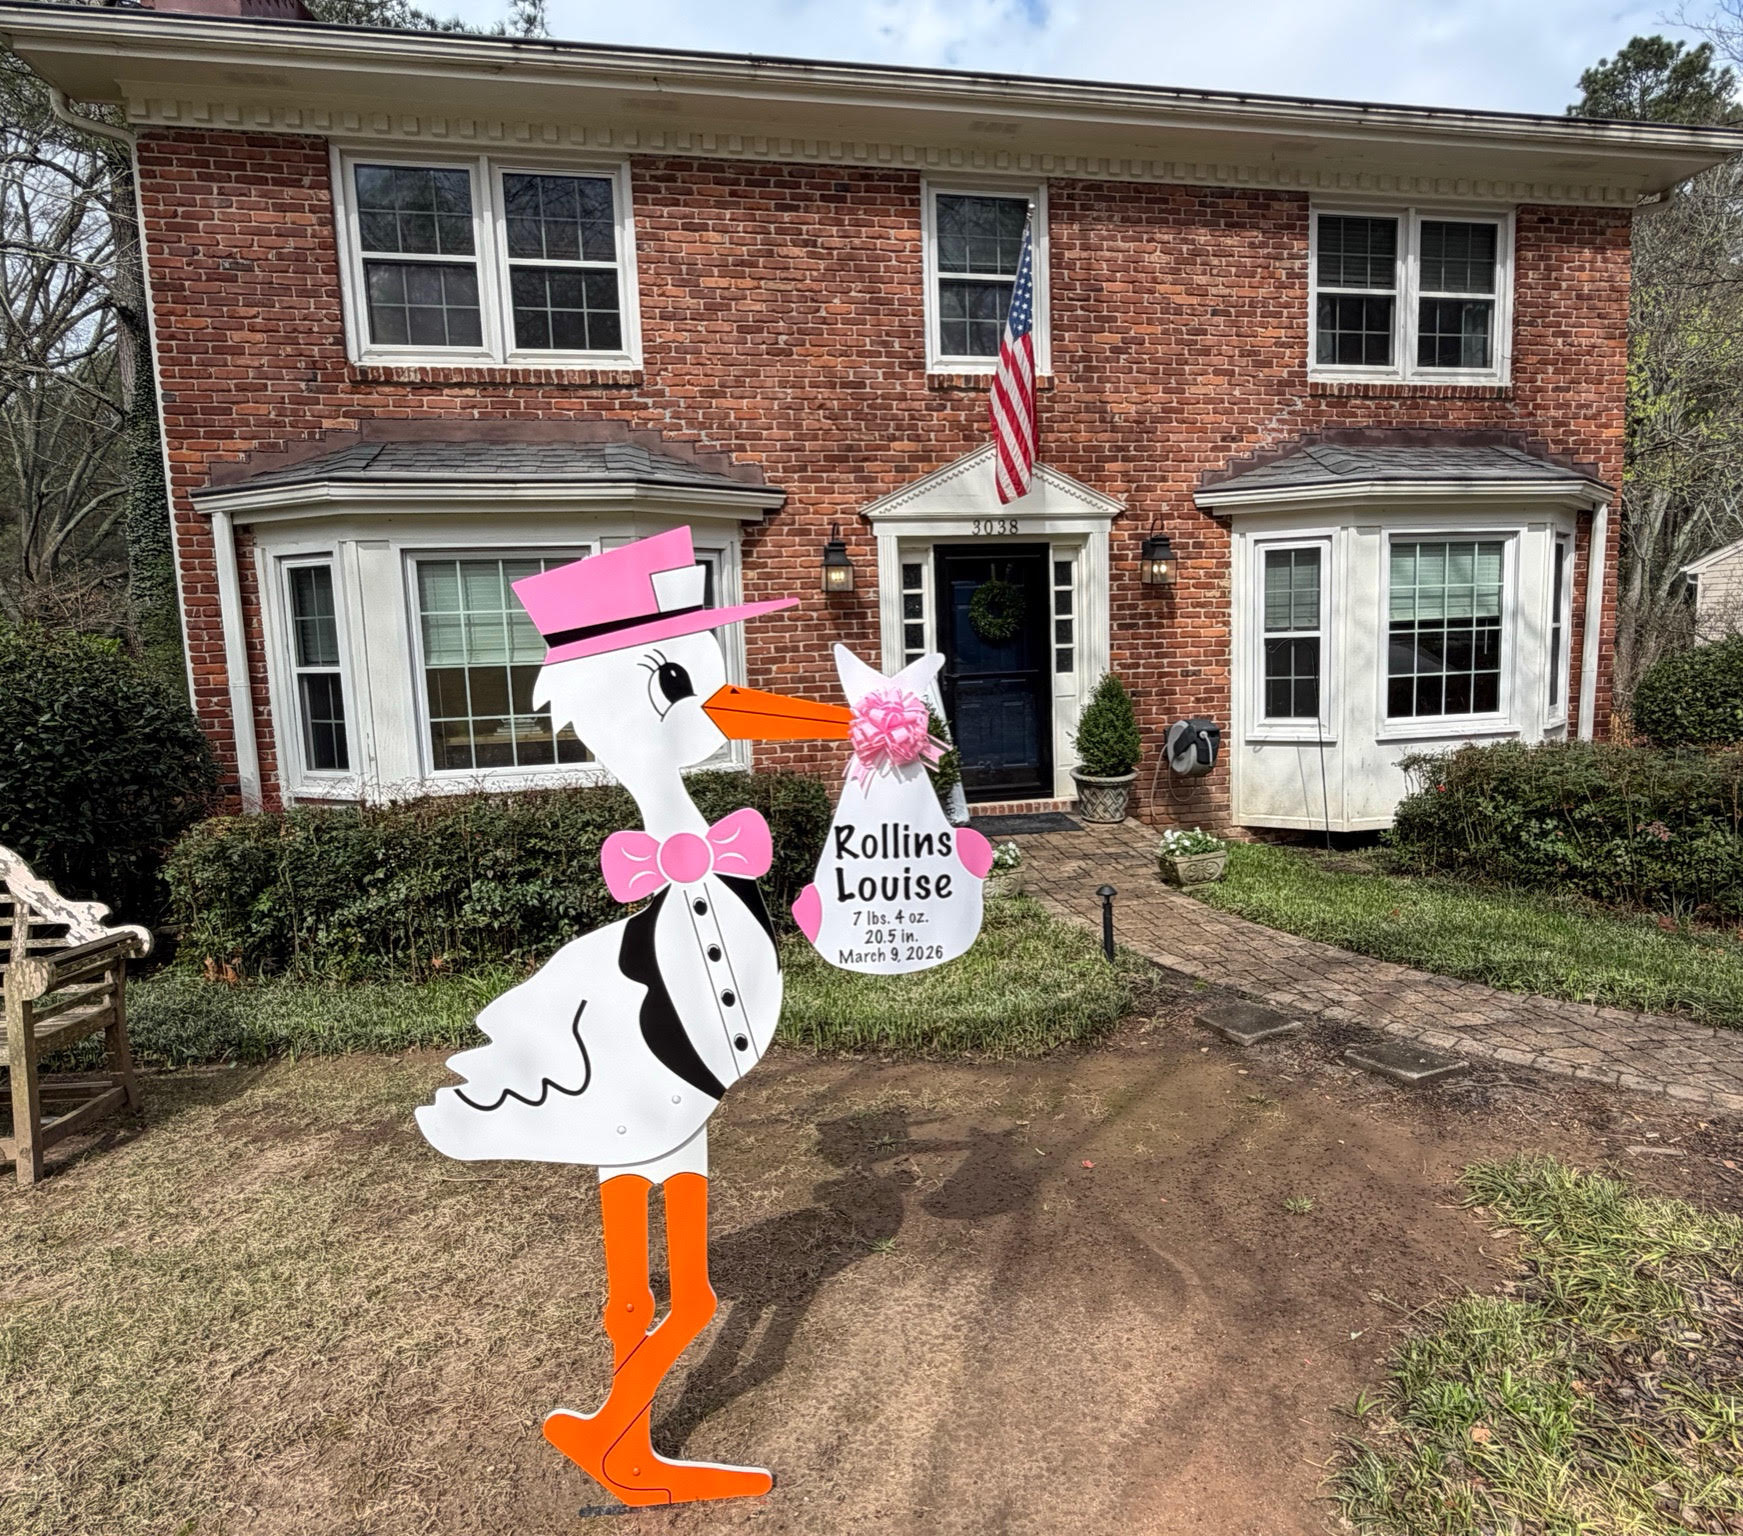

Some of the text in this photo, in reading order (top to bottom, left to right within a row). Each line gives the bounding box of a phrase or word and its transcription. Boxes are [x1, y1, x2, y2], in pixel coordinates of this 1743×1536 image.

[972, 519, 1018, 536] 3038
[834, 822, 952, 860] Rollins
[835, 866, 953, 903] Louise
[852, 909, 929, 926] 7 lbs. 4 oz.
[864, 929, 918, 945] 20.5 in.
[839, 945, 944, 964] March 9, 2026
